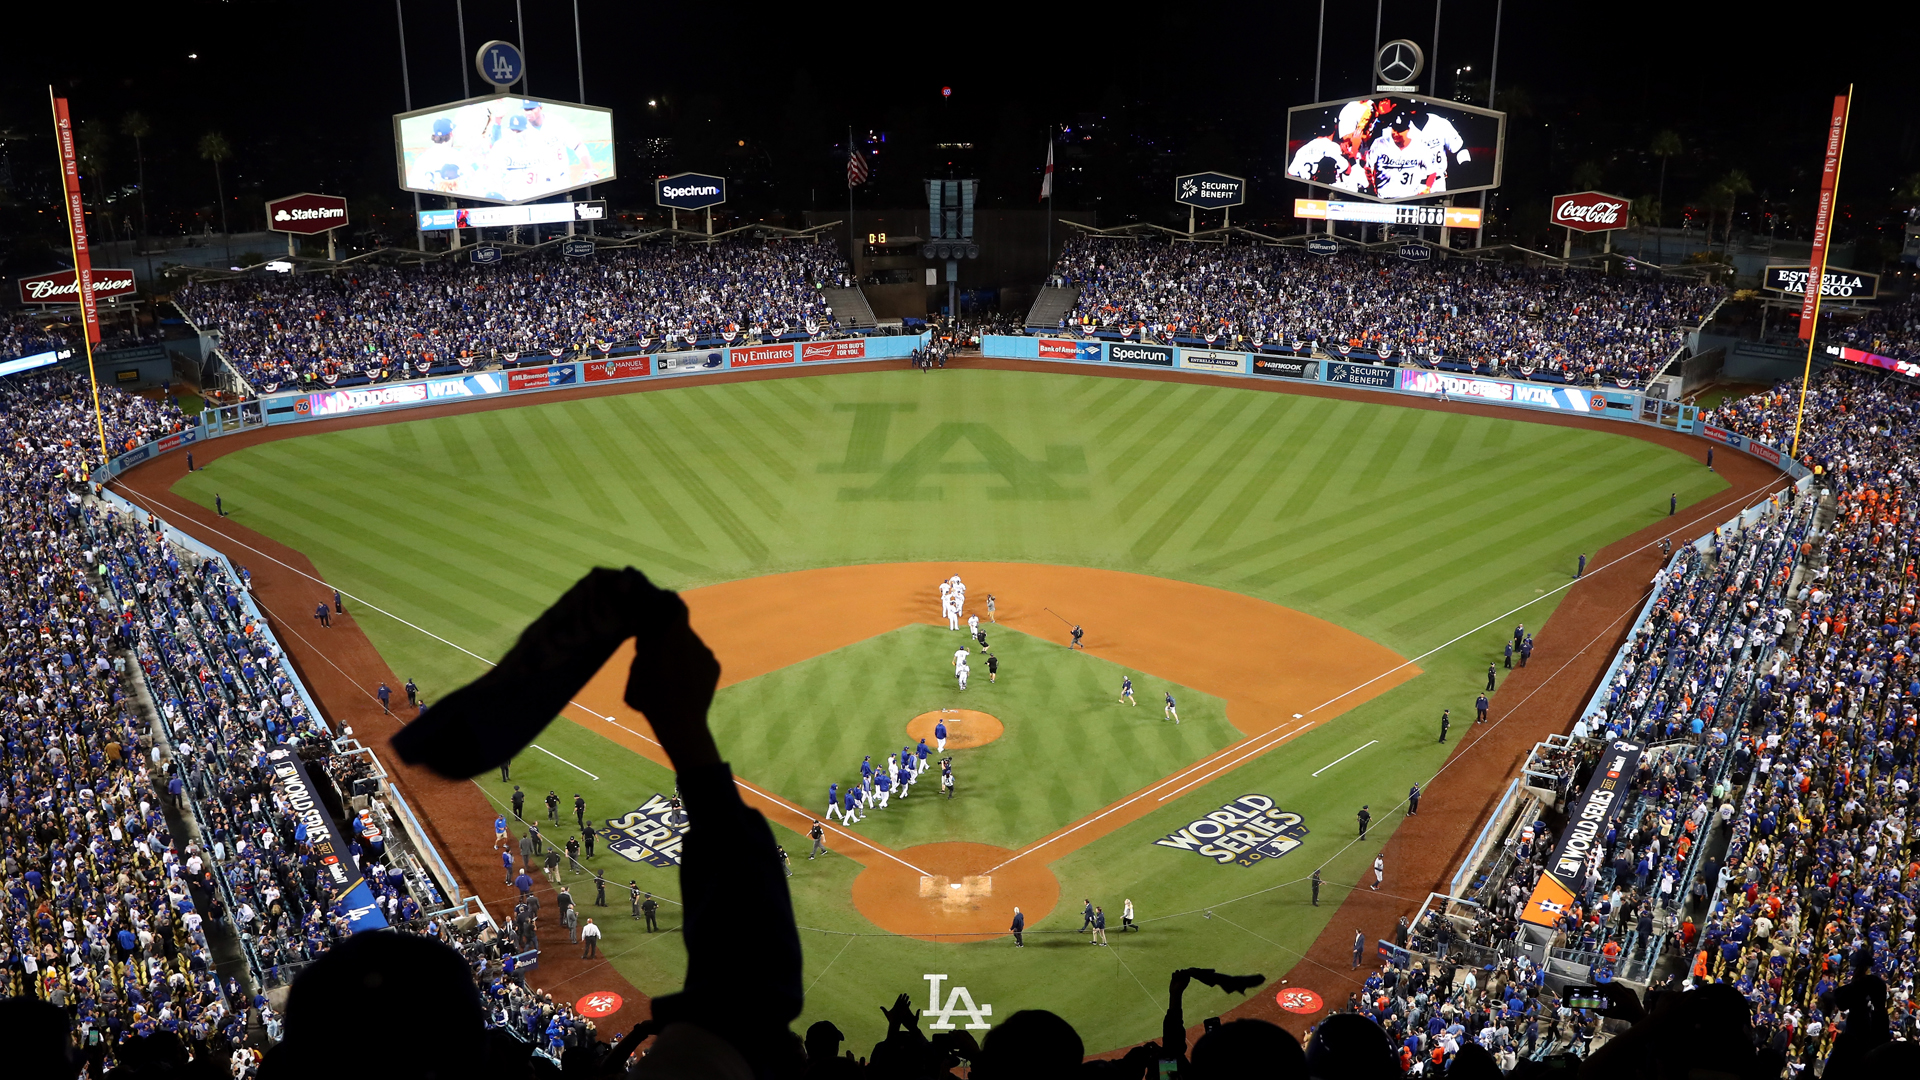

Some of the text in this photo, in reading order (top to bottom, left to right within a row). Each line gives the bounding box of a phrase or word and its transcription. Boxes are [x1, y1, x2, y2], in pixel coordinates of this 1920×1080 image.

[491, 50, 513, 78] LA
[61, 119, 76, 175] Fly Emirates
[1825, 116, 1841, 172] Fly Emirates
[1201, 181, 1239, 191] SECURITY
[1400, 172, 1414, 185] 31
[663, 185, 717, 199] Spectrum
[1200, 190, 1233, 199] BENEFIT
[1557, 200, 1622, 224] Coca-Cola
[1813, 192, 1830, 247] Fly Emirates
[71, 195, 87, 250] Fly Emirates
[1401, 248, 1428, 257] DASANI
[26, 277, 132, 299] Budeiser
[1778, 270, 1863, 288] ESTELLA
[1784, 280, 1853, 297] JASCO
[82, 270, 97, 323] Fly Emirates
[1802, 266, 1818, 320] Fly Emirates
[732, 350, 793, 363] Fly Emirates
[1040, 345, 1054, 353] Bank
[1061, 347, 1085, 355] America
[1112, 347, 1166, 362] Spectrum
[1349, 376, 1385, 386] BENEFIT
[1350, 366, 1391, 378] SECURITY
[297, 401, 309, 411] 76
[1592, 398, 1604, 408] 76
[815, 402, 1090, 501] LA
[1760, 446, 1779, 463] Emirates
[284, 775, 314, 811] WORLD
[299, 809, 331, 844] SERIES
[1156, 795, 1273, 850] WORLD
[1561, 820, 1599, 860] WORLD
[1580, 790, 1615, 822] SERIES
[1199, 808, 1302, 863] SERIES
[922, 974, 992, 1029] LA
